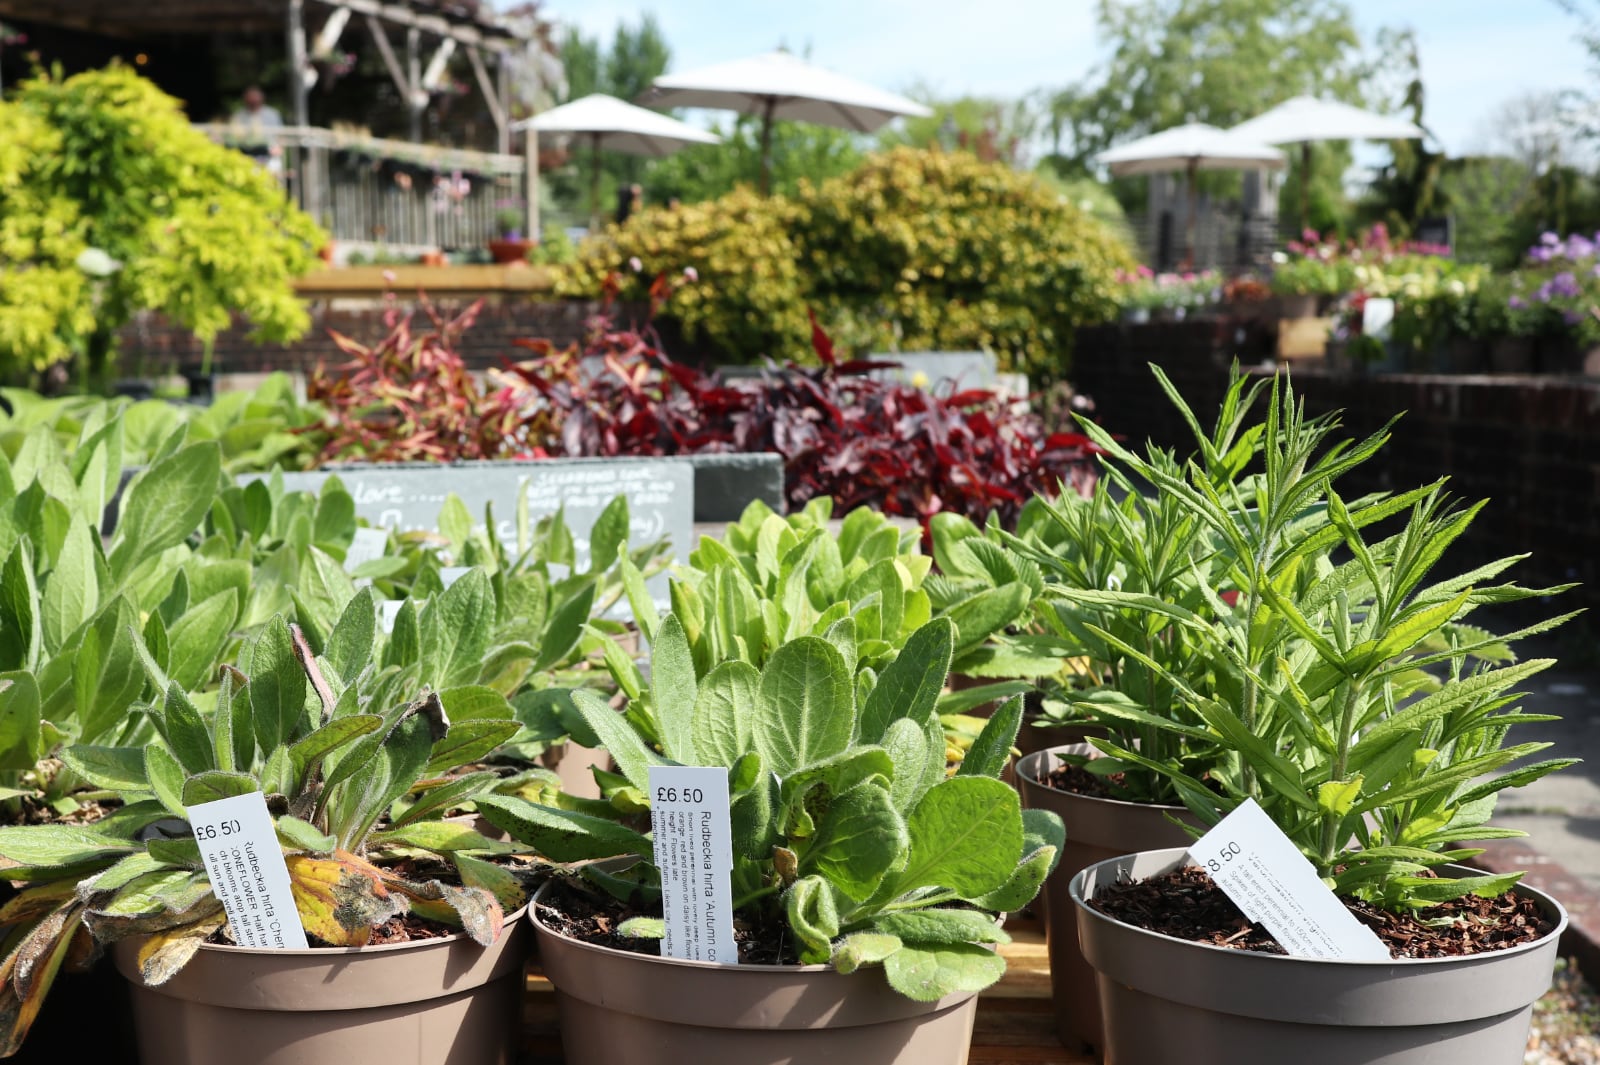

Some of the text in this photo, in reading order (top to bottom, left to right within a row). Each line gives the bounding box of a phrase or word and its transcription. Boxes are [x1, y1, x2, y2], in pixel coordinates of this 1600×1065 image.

[657, 787, 703, 803] £6.50
[196, 819, 241, 841] £6.50
[701, 811, 713, 869] Rudbeckia
[670, 837, 678, 865] Flowers
[1203, 841, 1241, 874] 8.50
[211, 863, 222, 880] sun
[217, 880, 229, 898] and
[703, 873, 714, 896] hirta
[222, 860, 240, 893] blooms
[231, 893, 246, 914] atop
[239, 913, 251, 927] tall
[260, 893, 276, 917] hirta
[682, 893, 688, 903] on
[252, 913, 265, 932] Half
[682, 905, 690, 923] daisy
